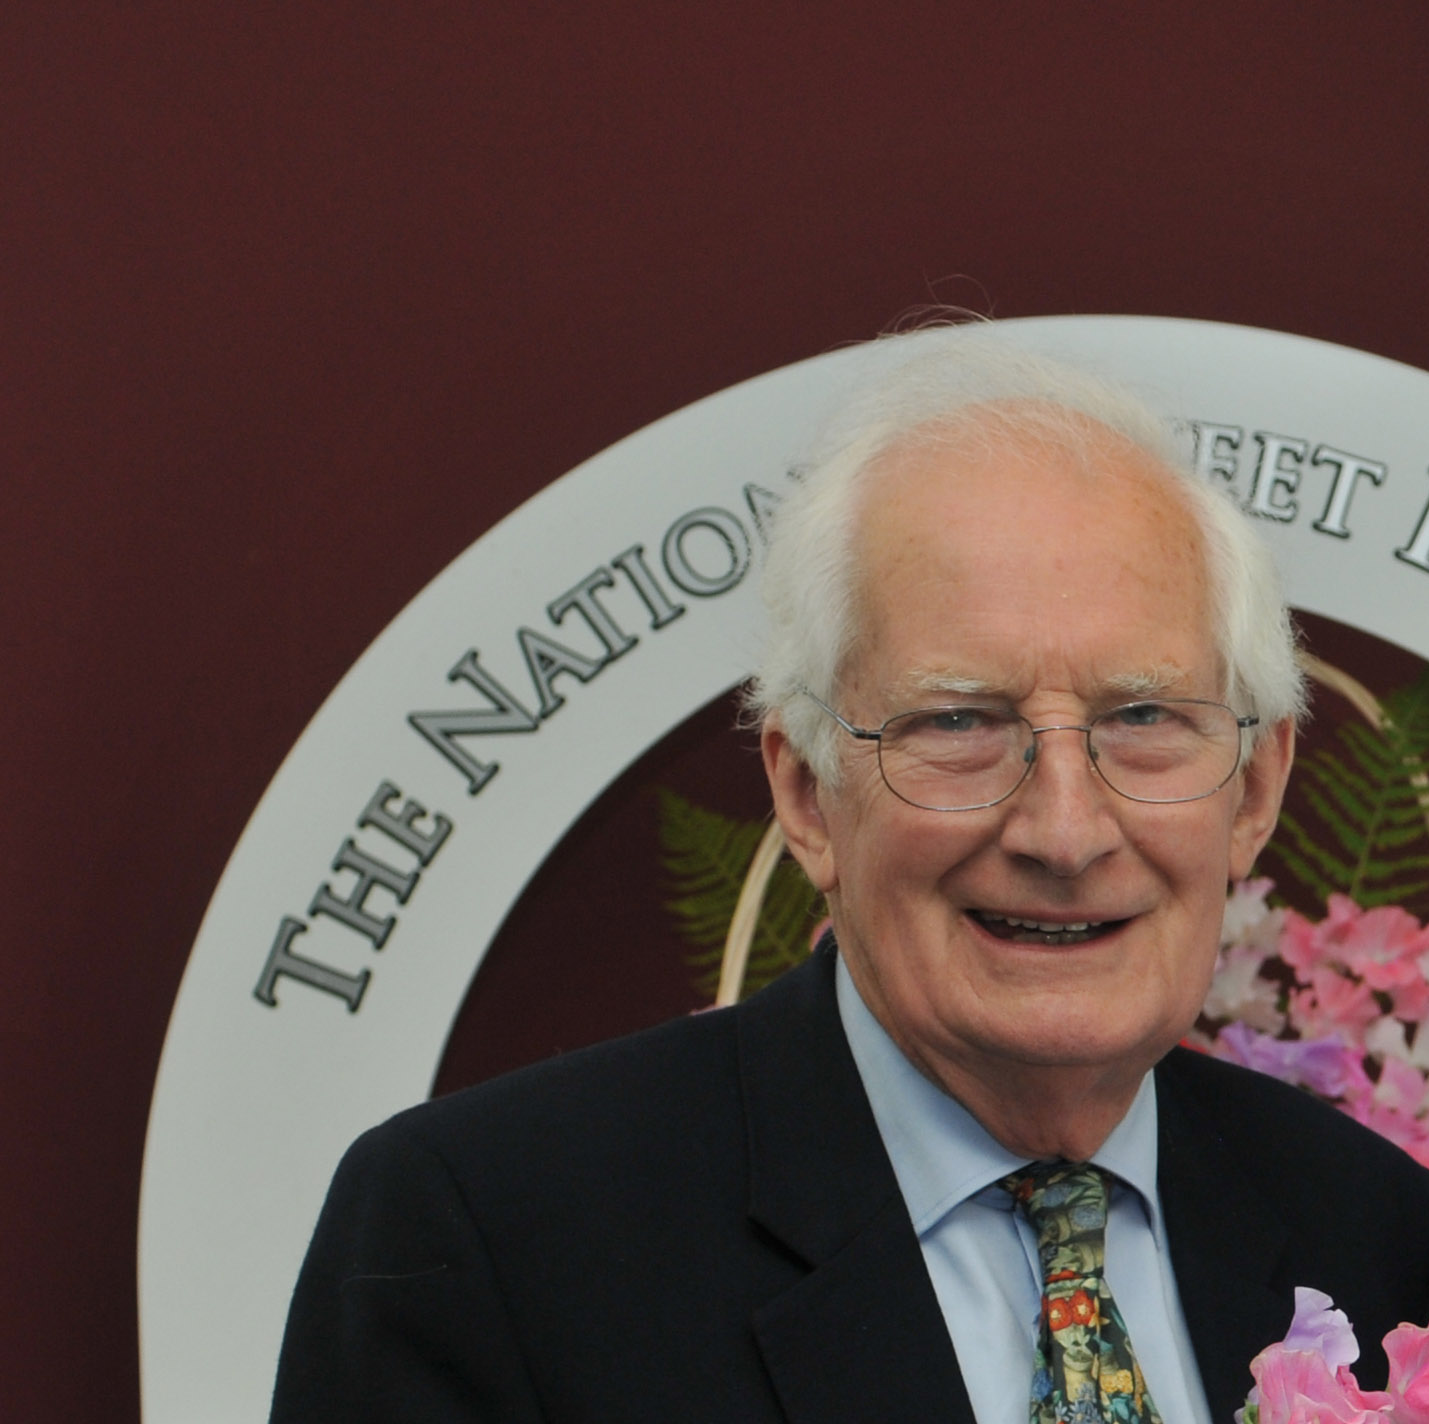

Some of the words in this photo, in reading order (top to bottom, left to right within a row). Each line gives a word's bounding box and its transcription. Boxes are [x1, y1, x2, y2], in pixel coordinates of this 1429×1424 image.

[253, 780, 452, 1014] THE
[407, 466, 800, 797] NATIO
[1190, 418, 1388, 540] EET
